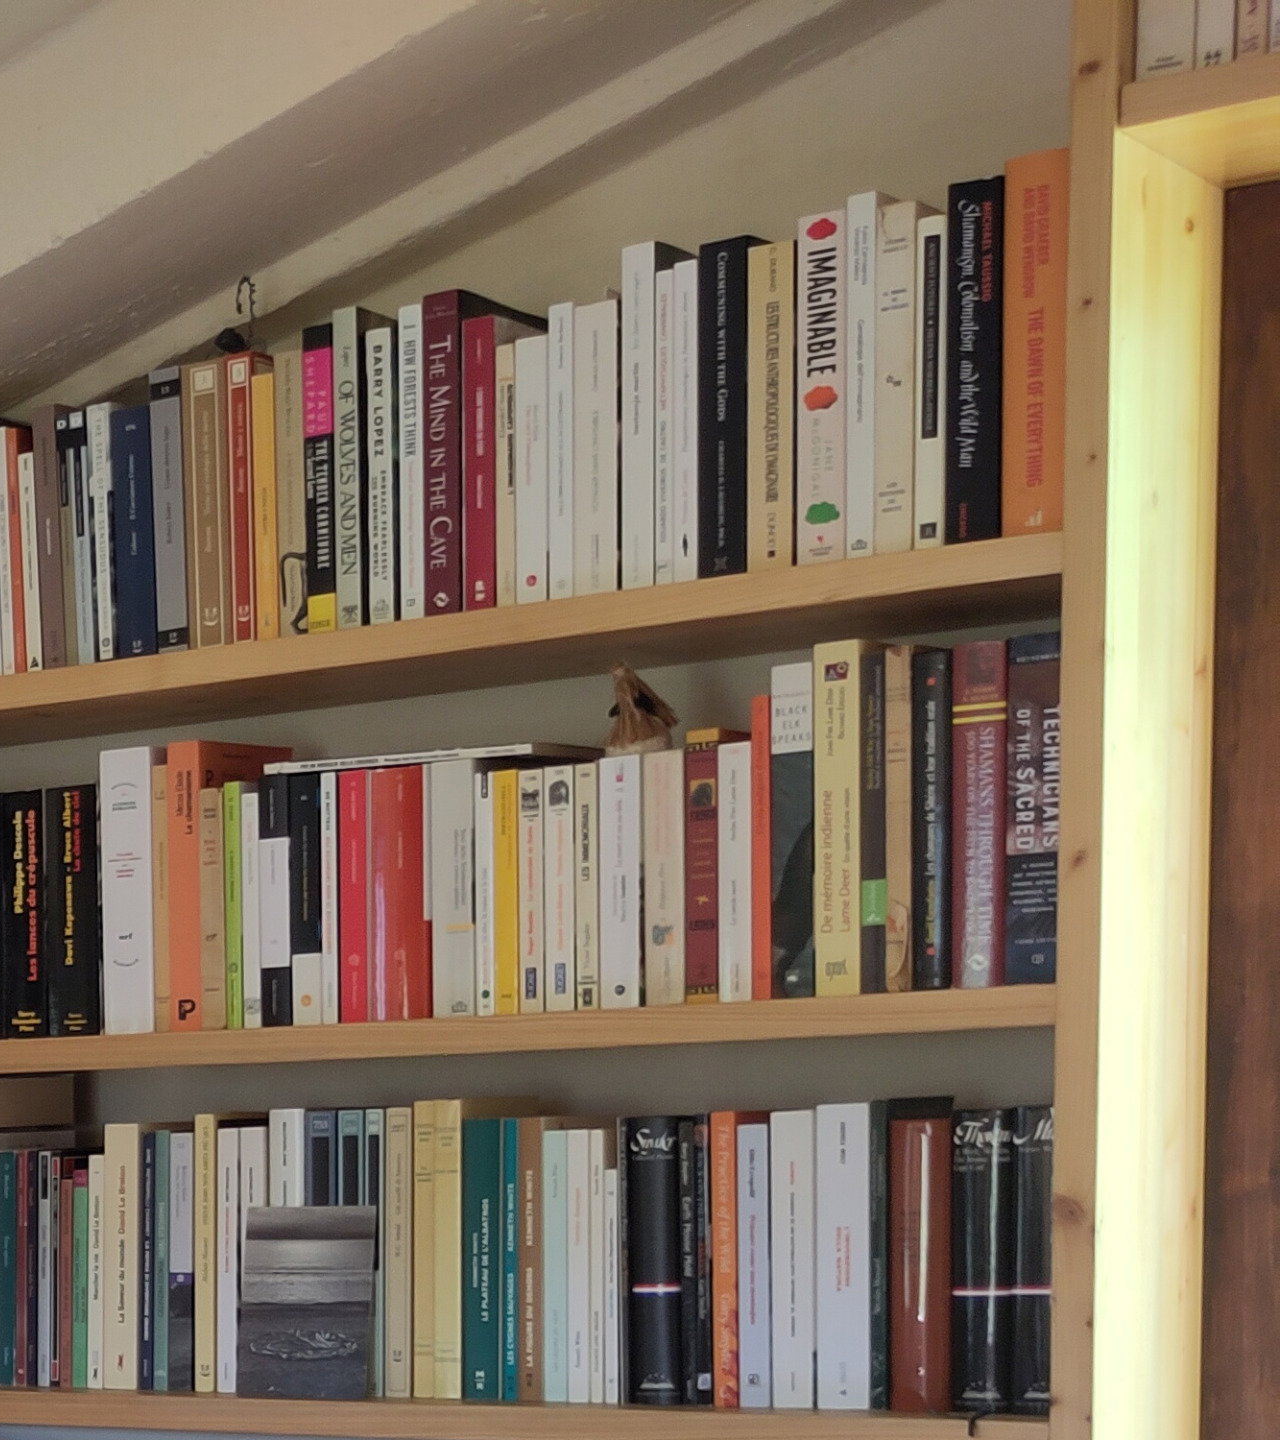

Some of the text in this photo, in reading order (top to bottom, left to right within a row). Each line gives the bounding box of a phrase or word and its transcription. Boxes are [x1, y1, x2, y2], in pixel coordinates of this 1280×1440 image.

[715, 252, 730, 422] COMMUNING WITH THE GODS
[805, 246, 838, 379] IMAGINABLE
[958, 360, 979, 381] and
[372, 344, 386, 459] BARRY LOPEZ
[402, 339, 417, 459] HOW FORESTS THINK
[427, 334, 453, 570] THE MIND IN THE CAVE
[955, 437, 976, 468] Man
[957, 402, 978, 434] Wild
[958, 383, 979, 400] the
[1025, 306, 1045, 489] THE DAWN OF EVERYTHING
[338, 379, 358, 577] OF WOLVES AND MEN
[775, 704, 808, 717] BLACK
[1042, 704, 1060, 849] TECHNICIANS
[978, 727, 994, 946] SHAMANS THROUGH TIME
[1014, 708, 1037, 850] OF THE SACRED
[819, 789, 834, 934] De mémoire indienne
[838, 867, 851, 933] Lame Deer
